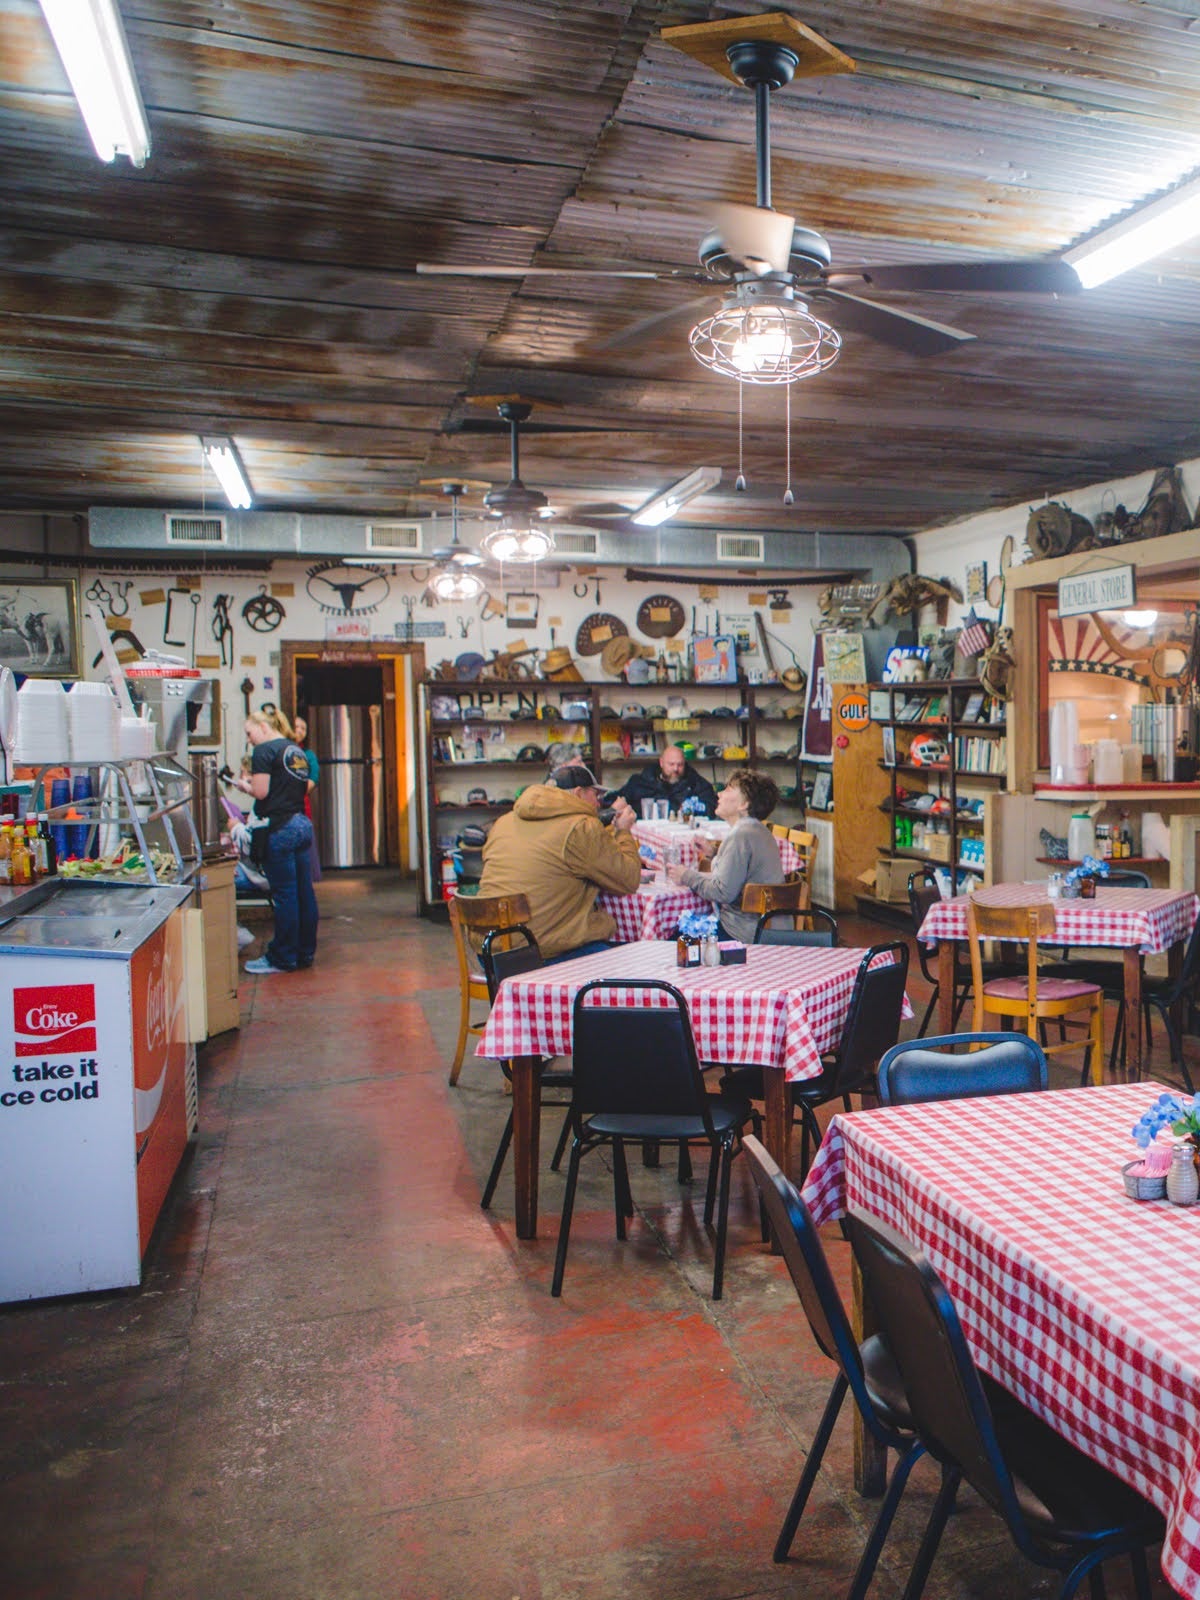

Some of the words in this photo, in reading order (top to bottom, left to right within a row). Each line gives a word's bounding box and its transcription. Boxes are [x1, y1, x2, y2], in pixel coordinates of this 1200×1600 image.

[1062, 580, 1098, 608] GENERAL
[1101, 575, 1127, 602] STORE
[840, 703, 868, 719] GULF
[26, 1008, 78, 1030] Coke
[12, 1062, 74, 1083] take
[80, 1059, 98, 1077] it
[40, 1081, 99, 1103] cold
